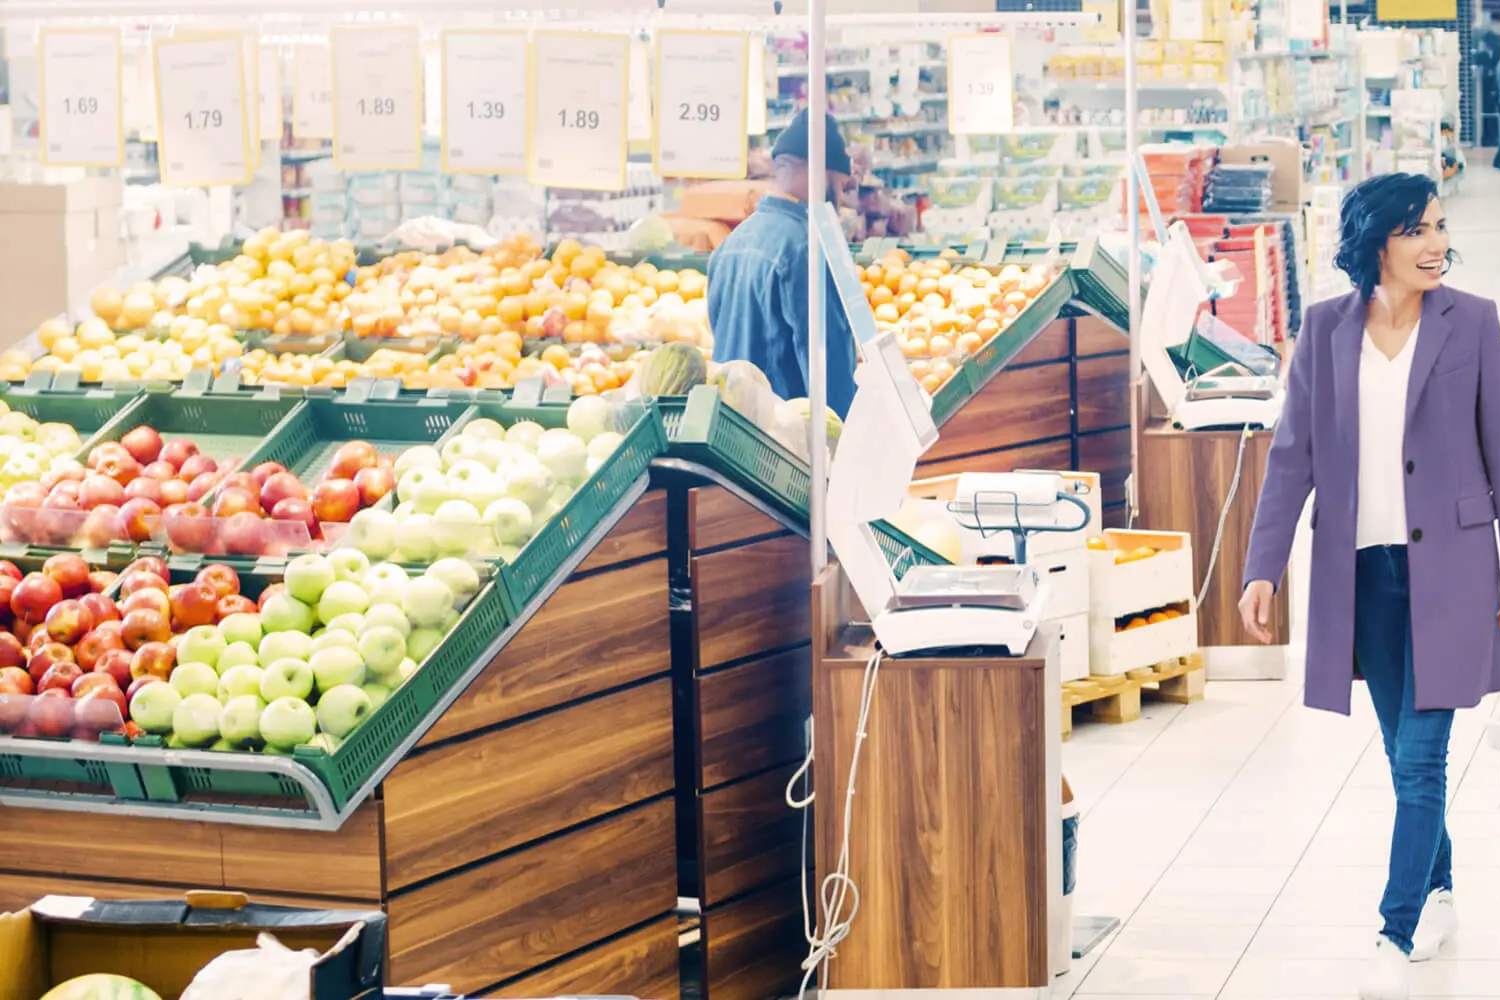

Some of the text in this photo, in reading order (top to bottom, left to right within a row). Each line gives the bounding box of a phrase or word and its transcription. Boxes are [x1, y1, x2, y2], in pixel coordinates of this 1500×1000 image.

[63, 97, 98, 115] 1.69
[358, 98, 395, 116] 1.89
[466, 101, 505, 120] 1.39
[679, 103, 720, 122] 2.99
[184, 110, 223, 130] 1.79
[557, 108, 600, 130] 1.89
